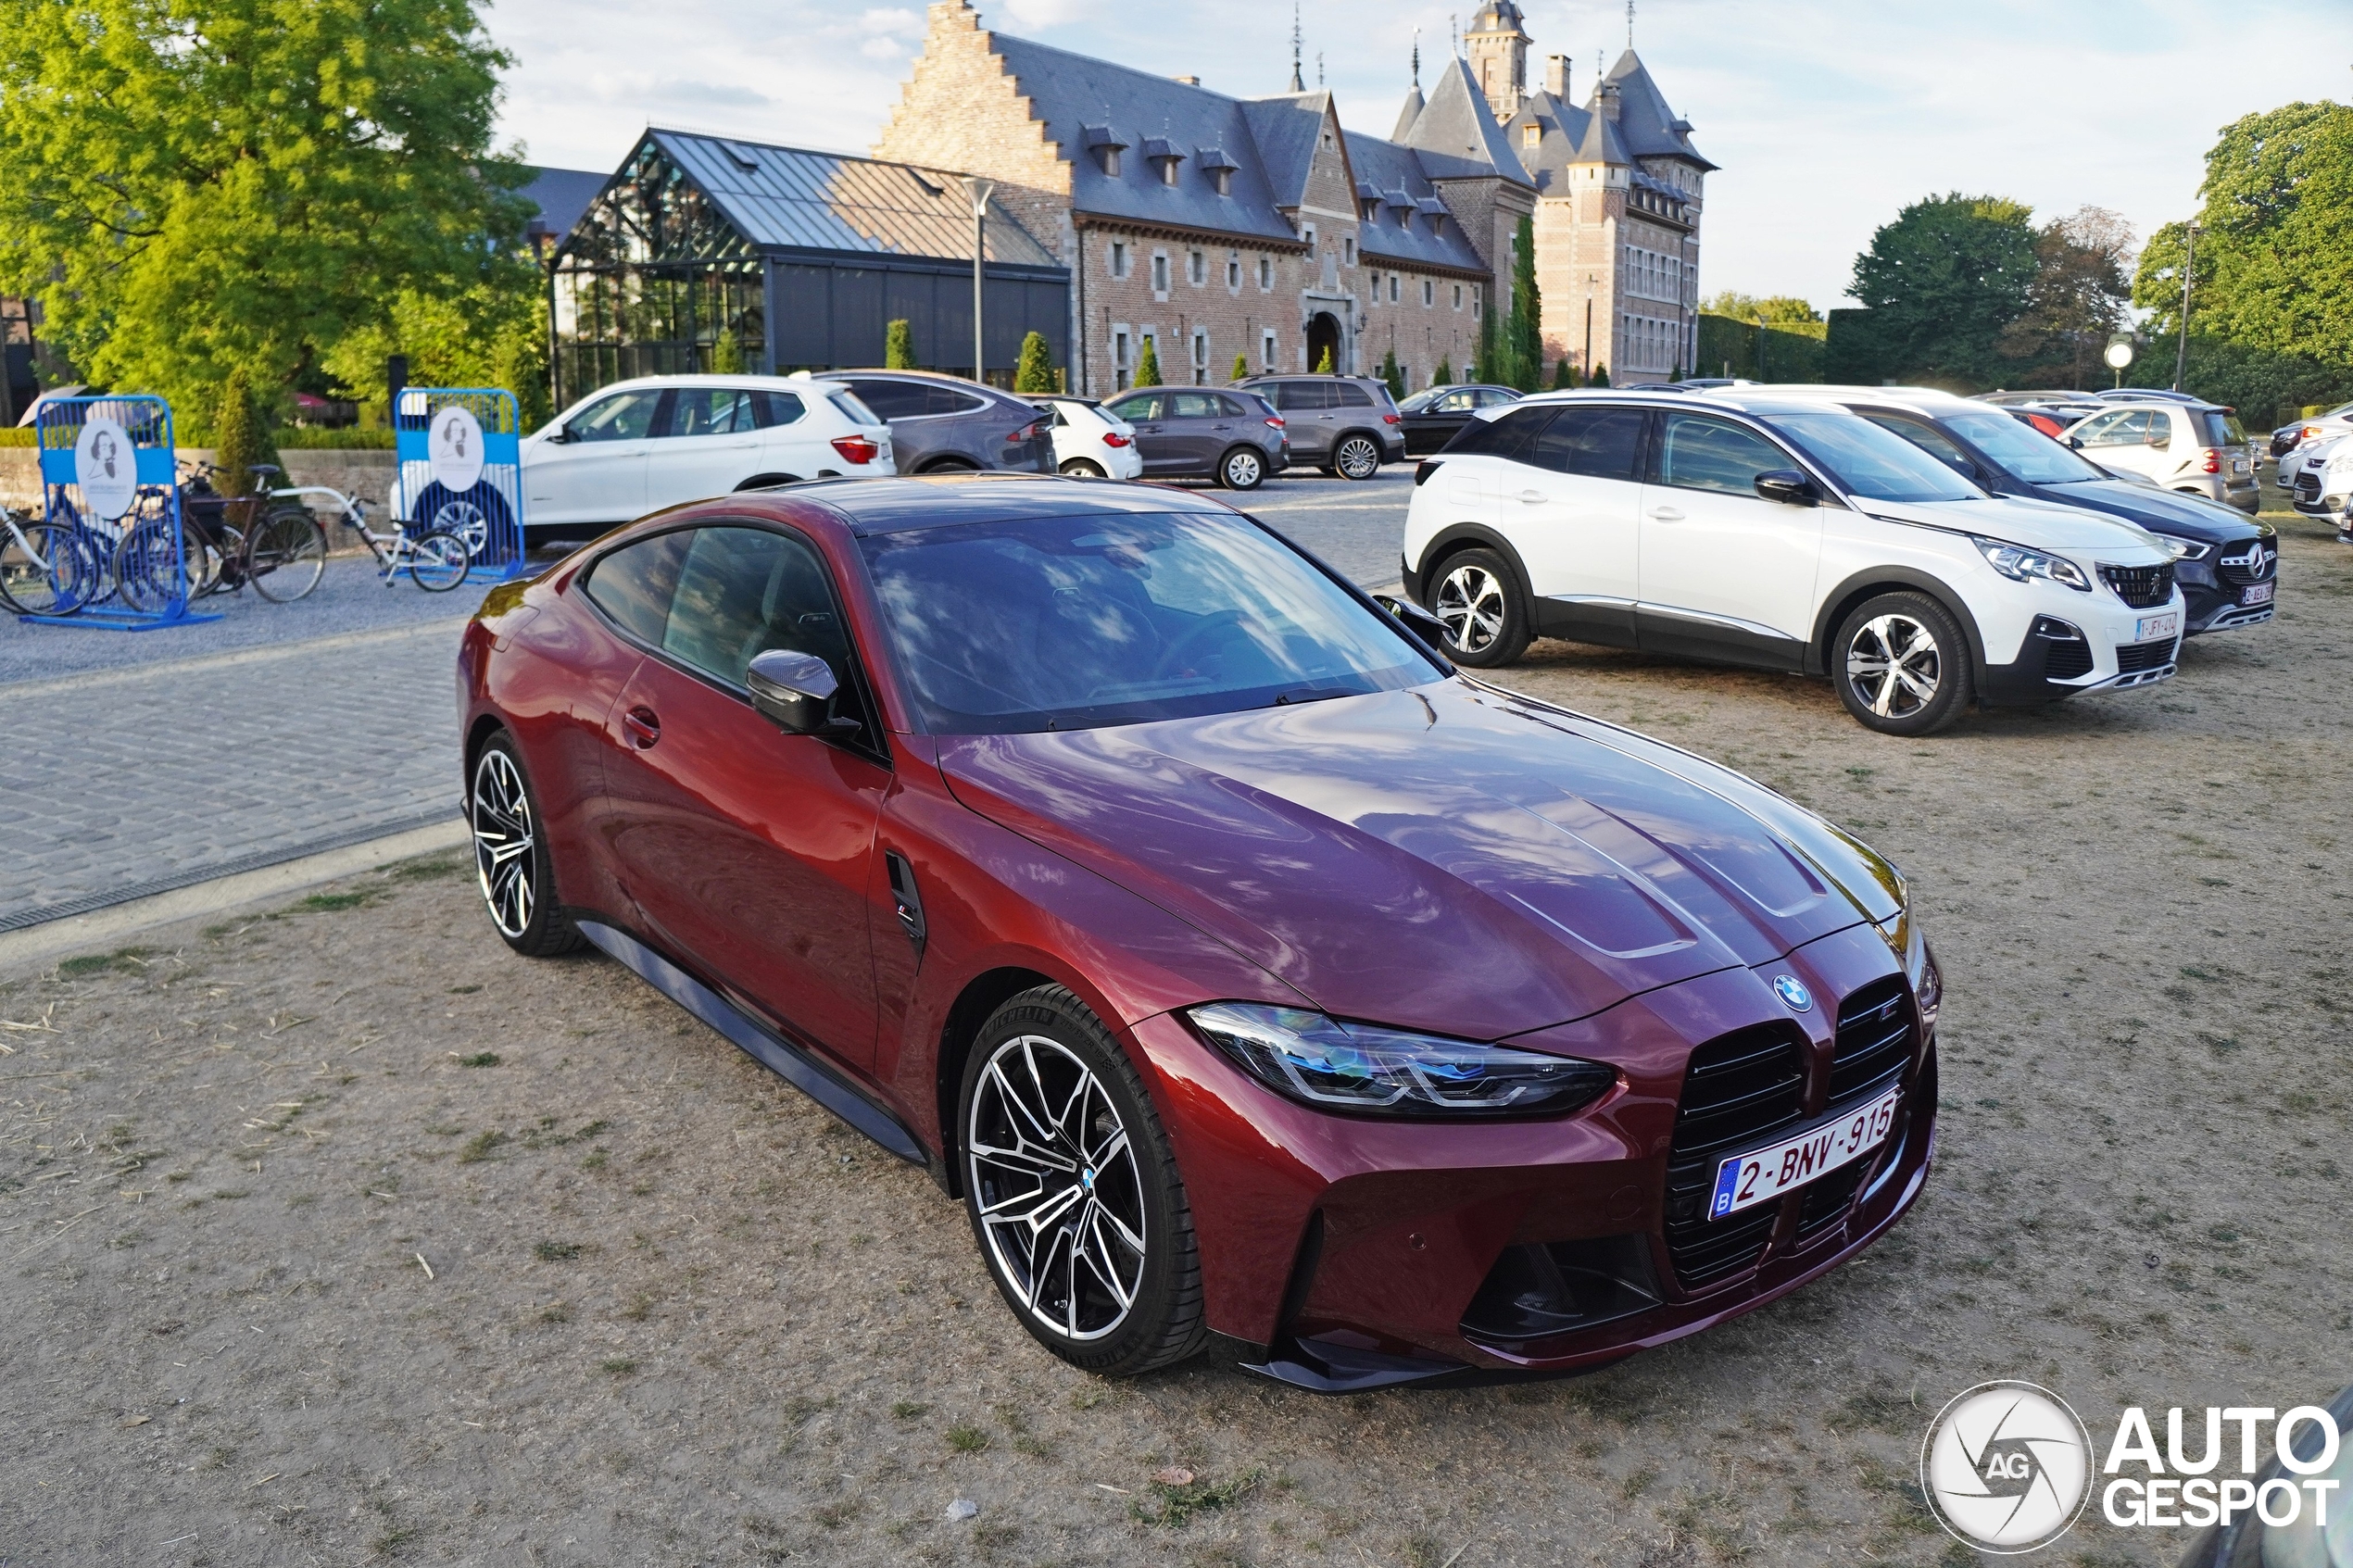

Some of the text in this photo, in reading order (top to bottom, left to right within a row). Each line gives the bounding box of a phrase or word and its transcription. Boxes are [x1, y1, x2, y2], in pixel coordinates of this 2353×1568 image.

[985, 1007, 1052, 1038] MICHELIN
[1736, 1098, 1894, 1203] 2-BNV-915
[1716, 1192, 1730, 1212] B
